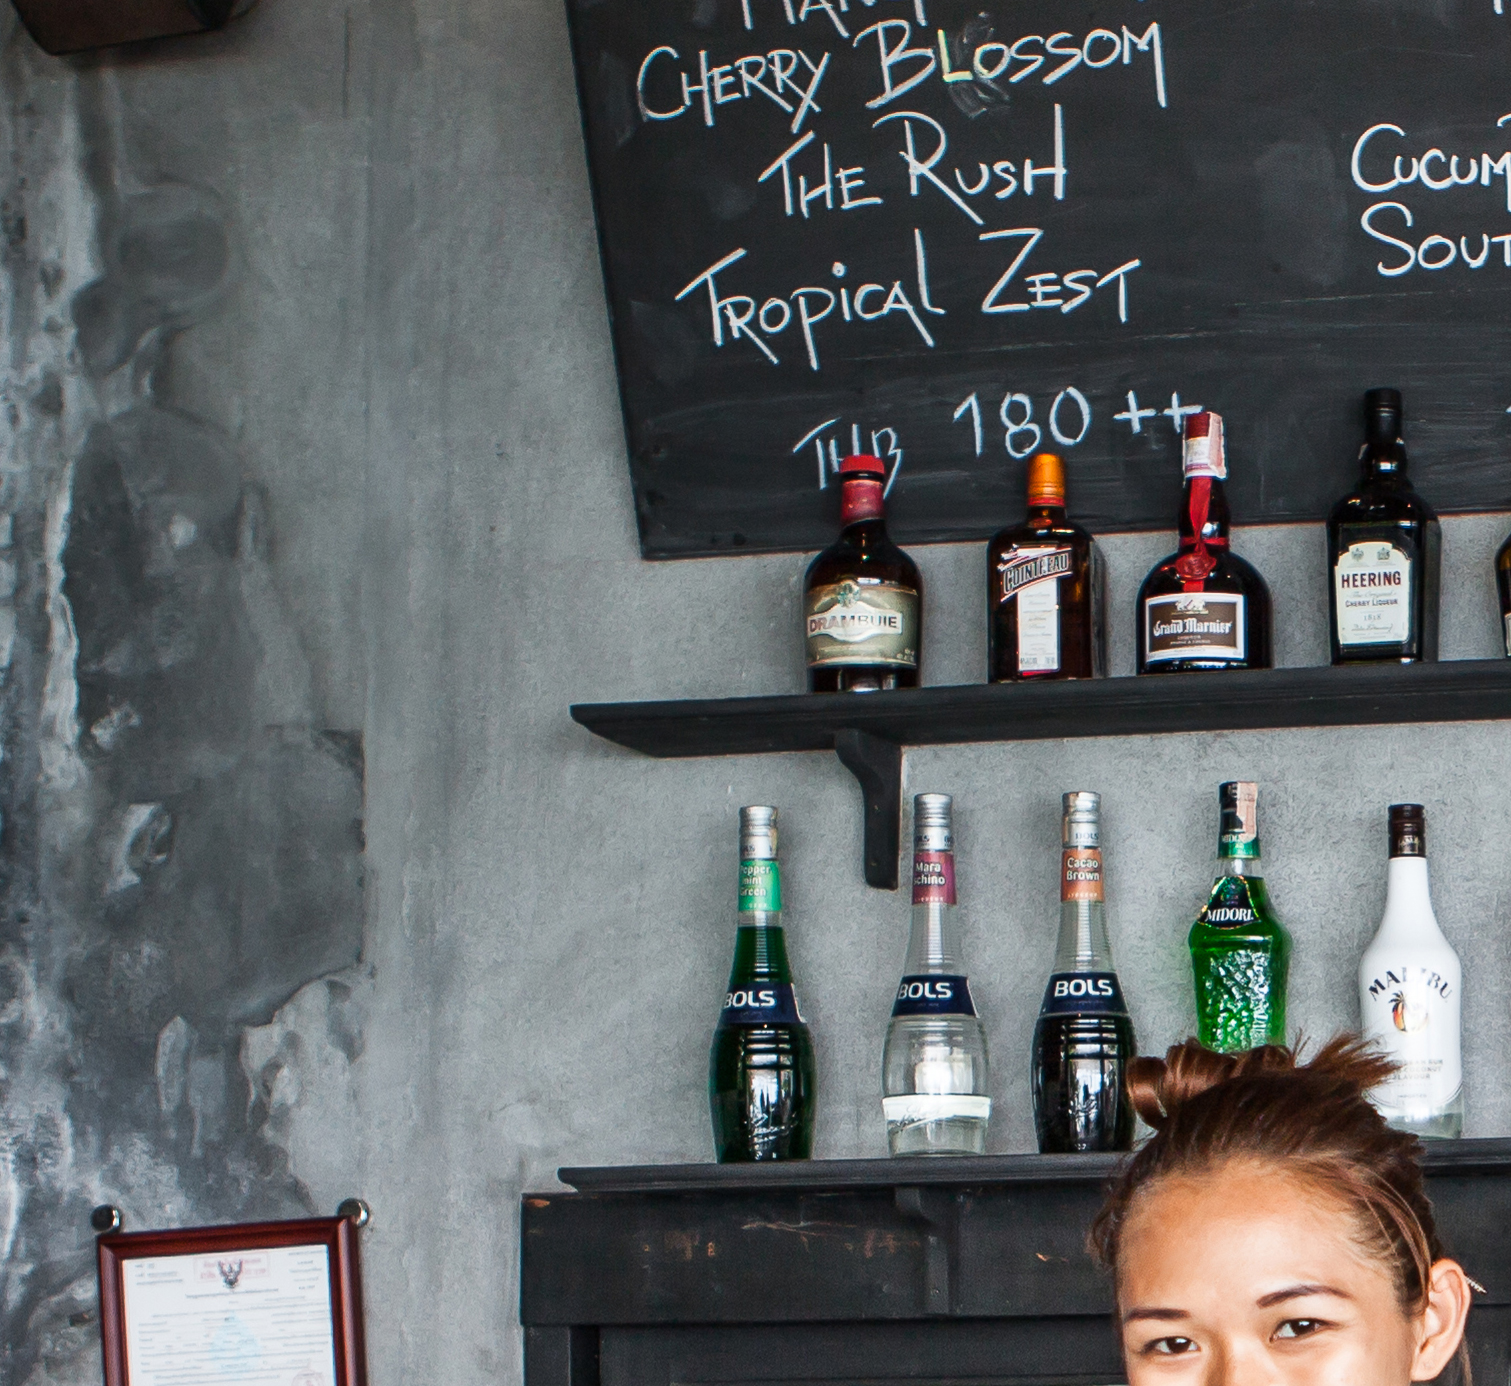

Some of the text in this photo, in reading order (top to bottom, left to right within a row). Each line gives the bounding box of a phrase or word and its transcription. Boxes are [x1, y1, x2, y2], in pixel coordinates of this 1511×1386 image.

[637, 46, 830, 134] CHERRY
[852, 19, 1168, 108] BLOSSOM
[757, 102, 1069, 225] THE RUSH
[979, 227, 1142, 324] ZEST
[953, 386, 1091, 460] 180
[1340, 570, 1402, 589] HEERING
[809, 615, 898, 633] DRAMBUIE
[1152, 617, 1234, 637] Grand Marnier
[915, 862, 942, 873] Mara
[1066, 857, 1099, 869] Cacao
[1066, 869, 1100, 882] Brown
[897, 981, 953, 1000] BOLS
[1053, 978, 1114, 998] BOLS
